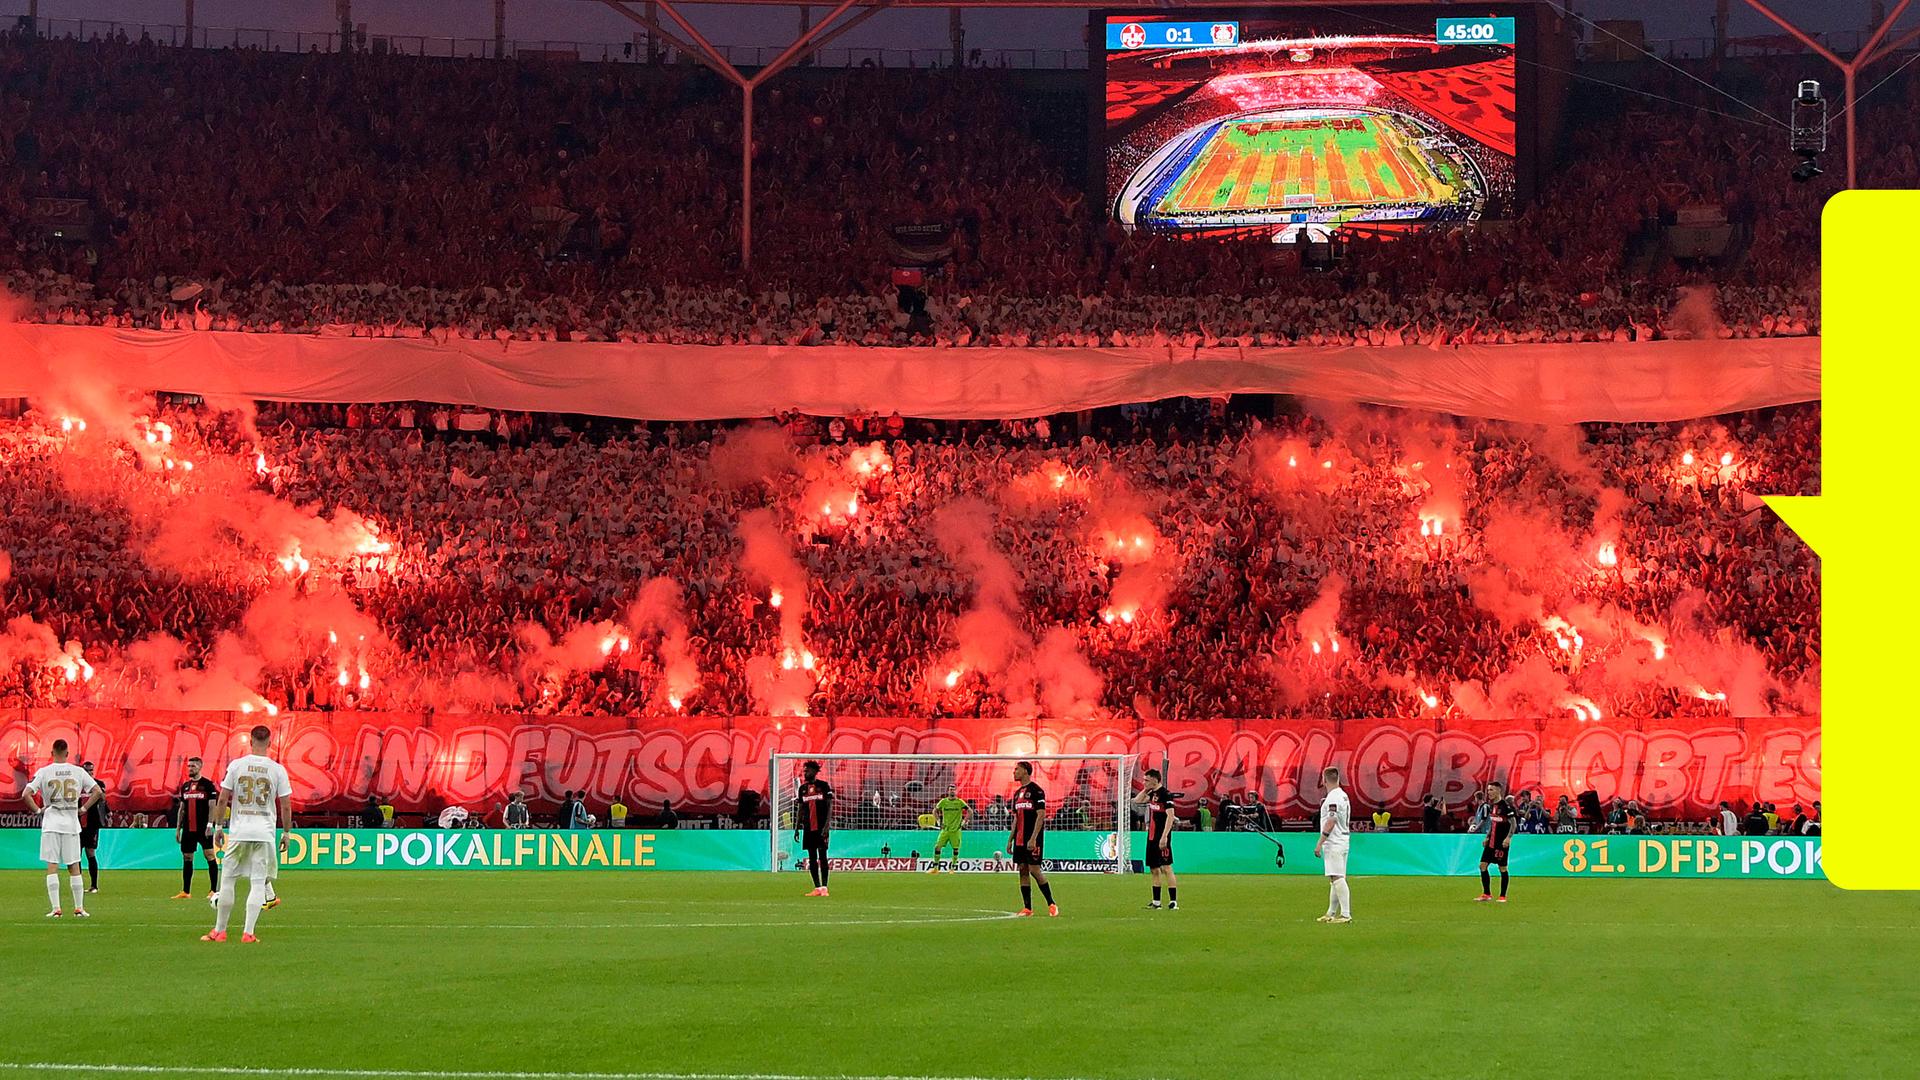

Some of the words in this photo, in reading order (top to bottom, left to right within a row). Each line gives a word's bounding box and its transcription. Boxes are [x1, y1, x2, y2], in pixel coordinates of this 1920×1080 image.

[1166, 28, 1193, 42] 0:1
[1444, 24, 1494, 39] 45:00
[346, 724, 441, 803] IN
[48, 778, 77, 802] 26
[237, 776, 271, 806] 33
[280, 832, 656, 866] DFB-POKALFINALE
